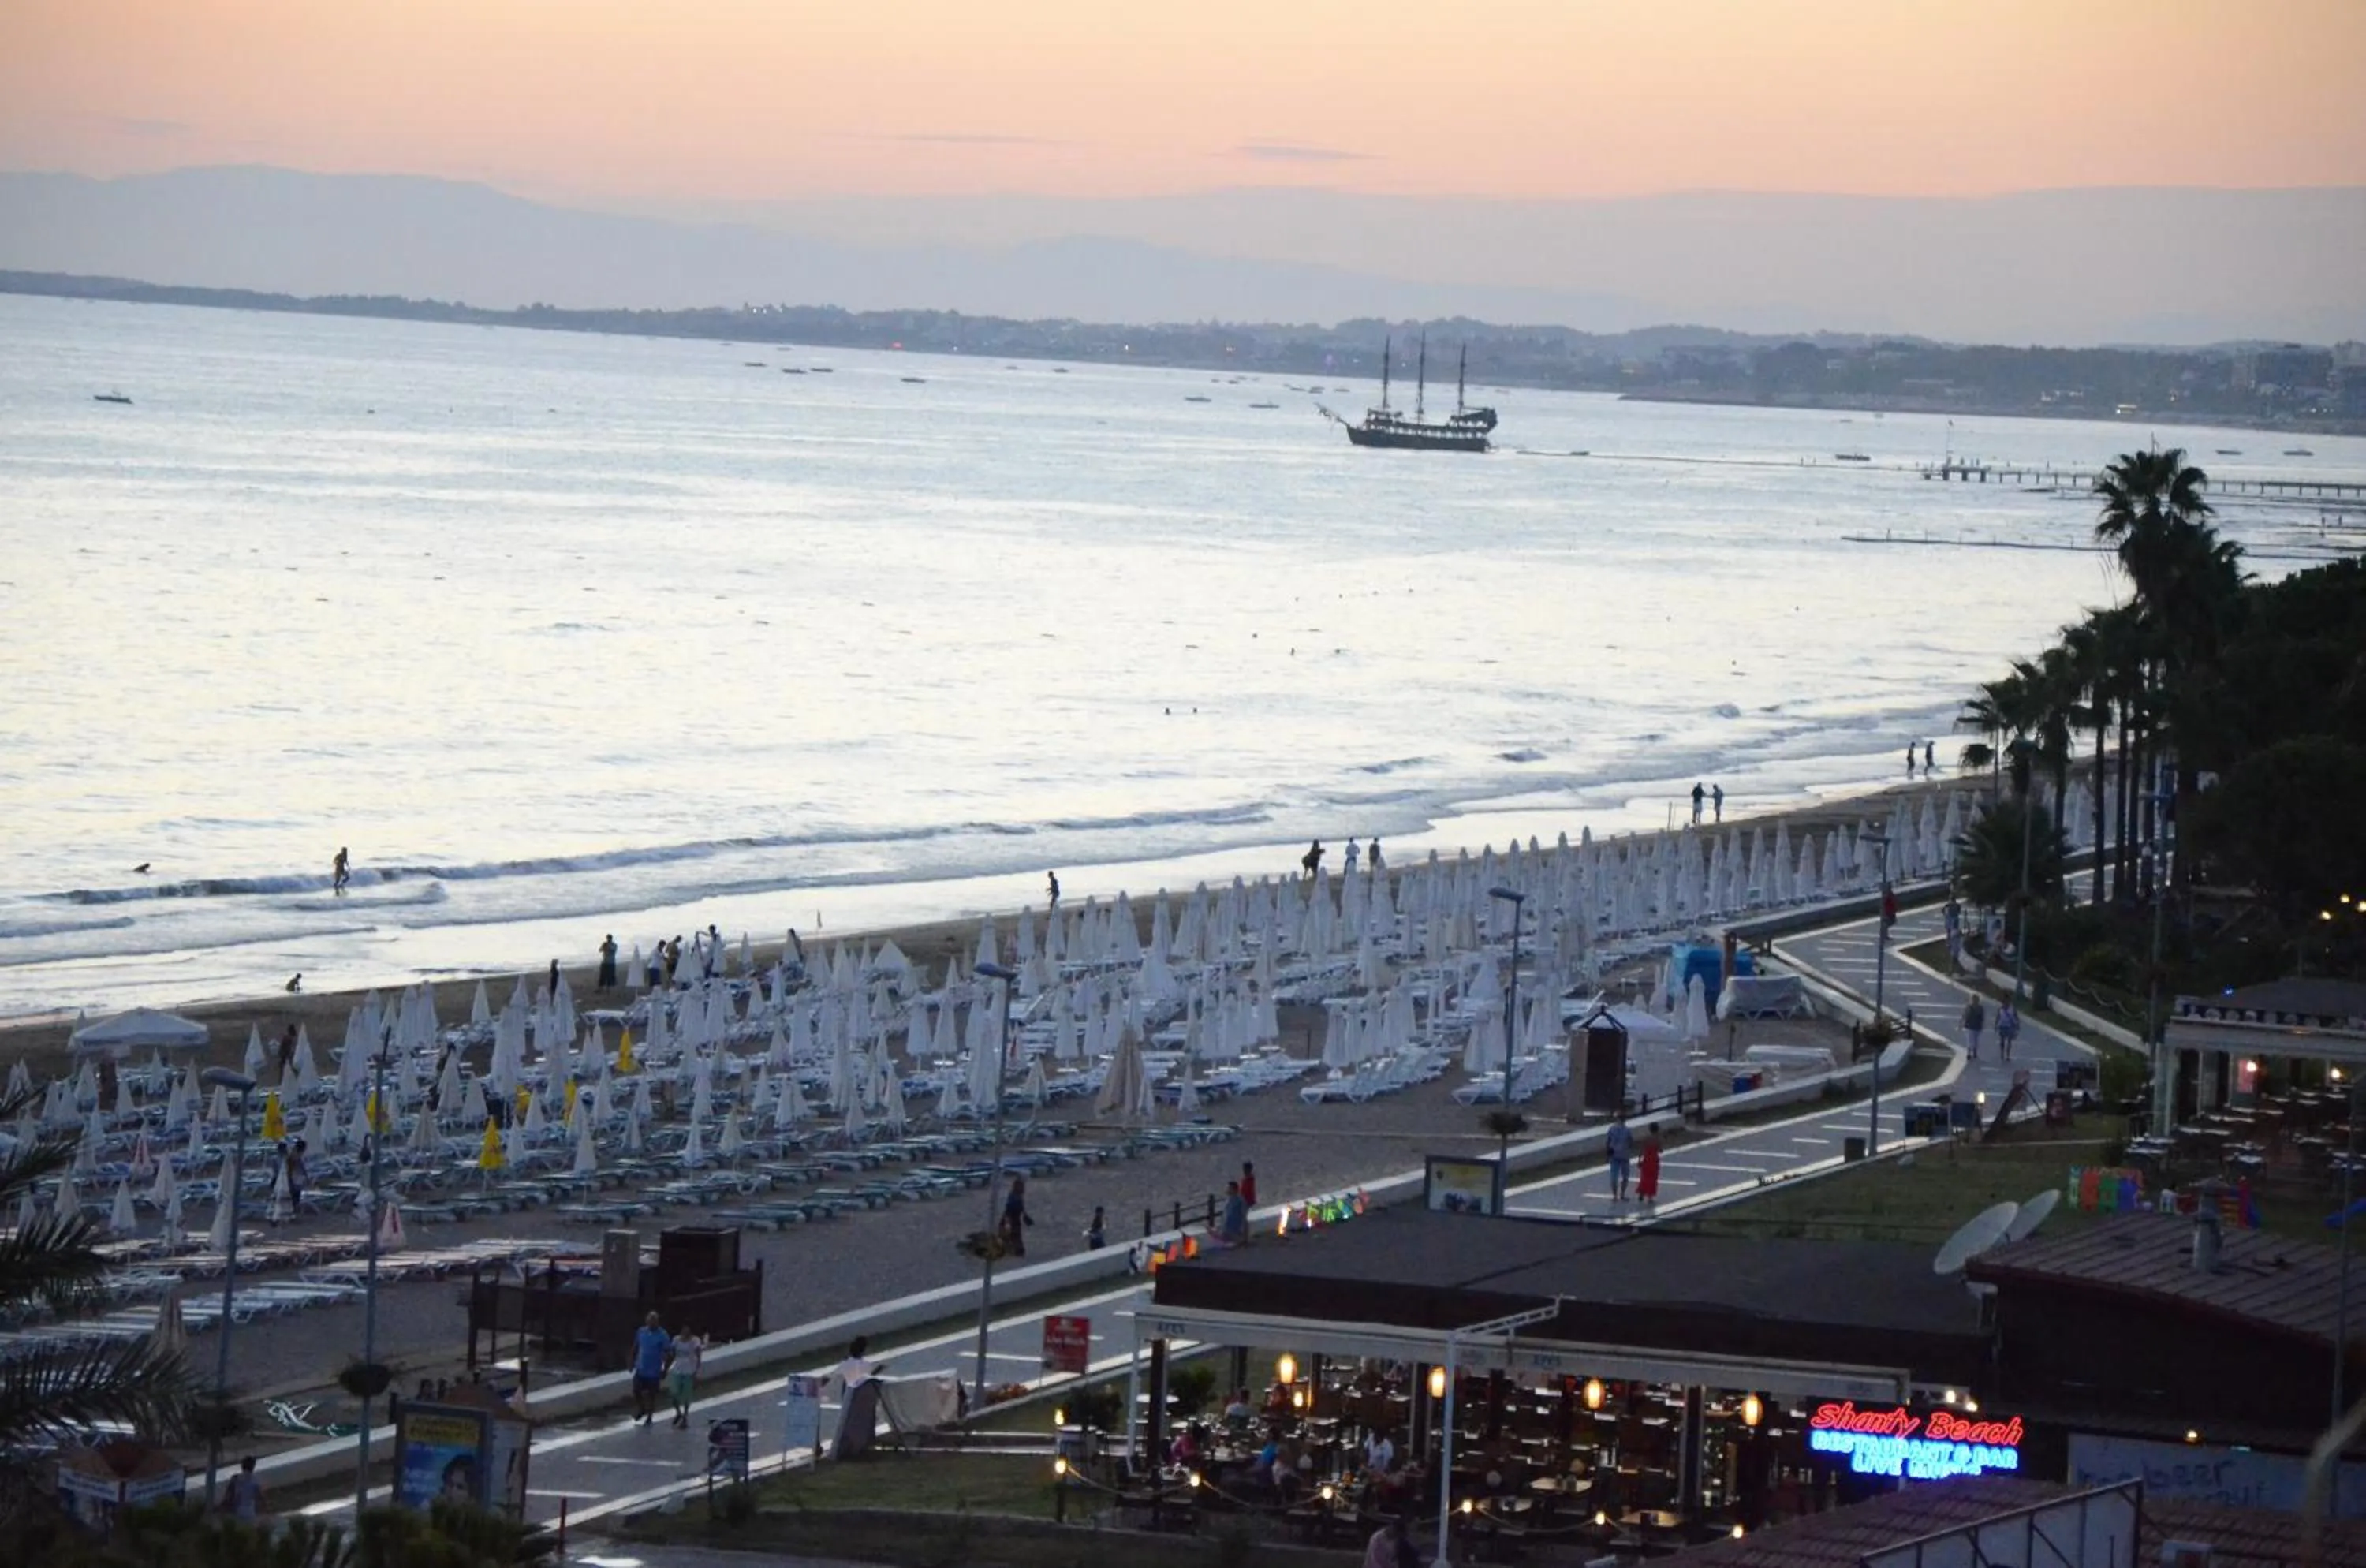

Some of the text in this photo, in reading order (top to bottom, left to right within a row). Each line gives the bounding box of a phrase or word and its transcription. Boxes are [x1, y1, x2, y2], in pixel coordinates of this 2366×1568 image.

[1810, 1401, 2024, 1445] Shanty Beach
[1851, 1453, 1902, 1475] LIVE
[1972, 1447, 2019, 1469] BAR
